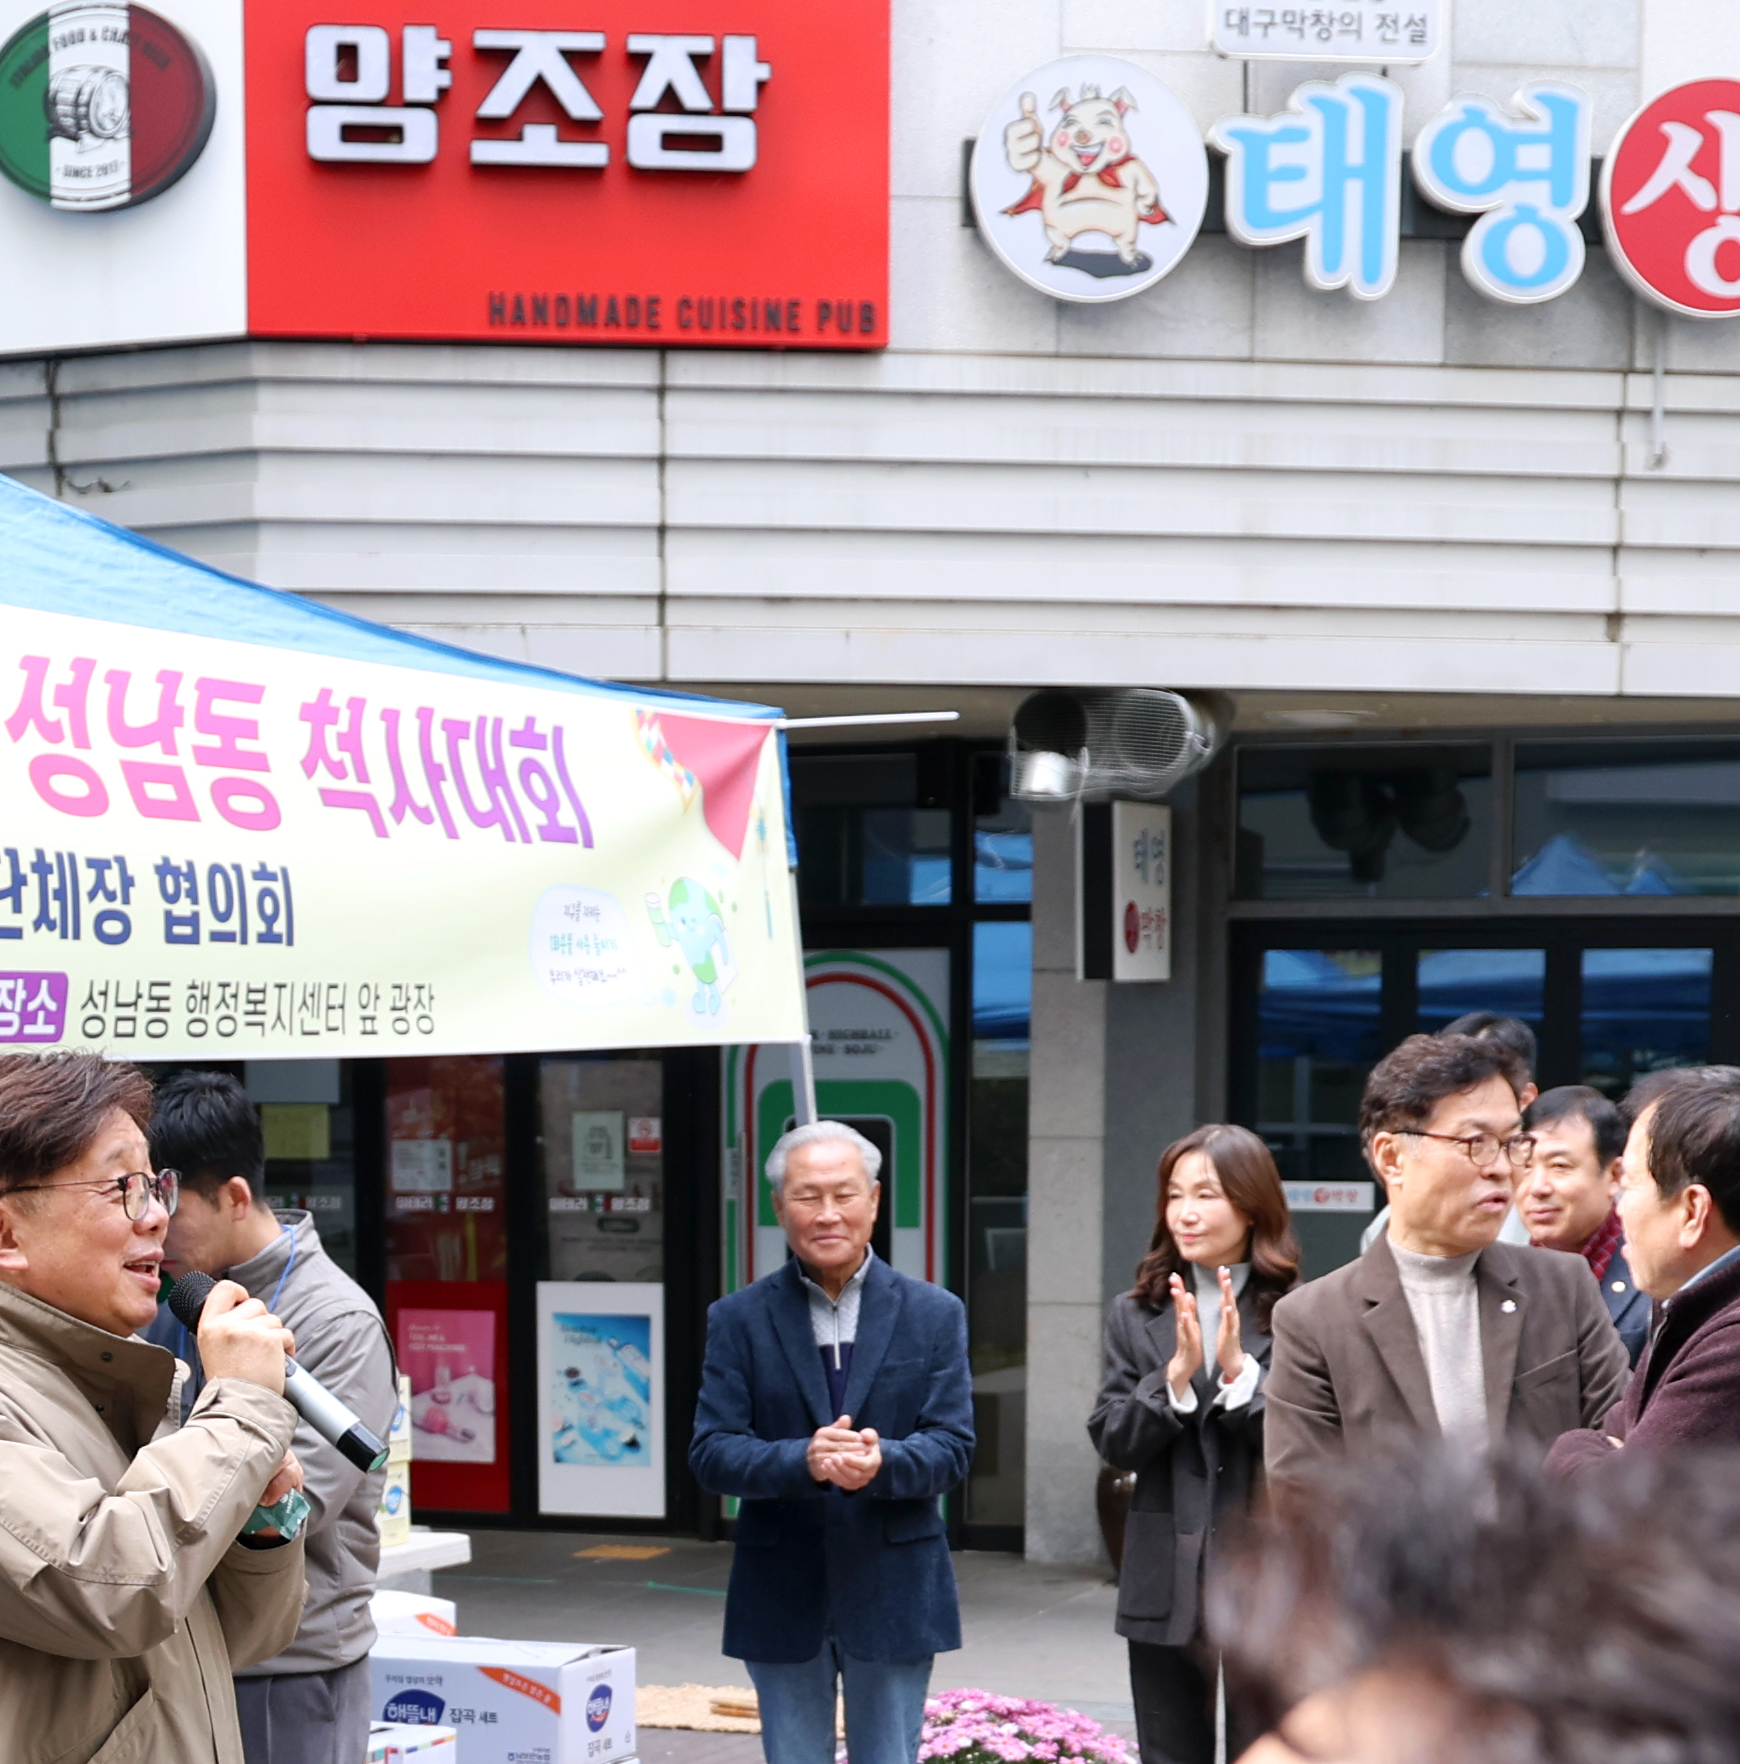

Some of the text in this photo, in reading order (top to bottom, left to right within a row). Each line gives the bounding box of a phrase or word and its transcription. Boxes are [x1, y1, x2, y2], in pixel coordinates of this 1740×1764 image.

[53, 27, 85, 50] FOOD
[1225, 8, 1428, 44] 대구막창의 전설
[304, 23, 772, 173] 양조장
[63, 164, 92, 178] SINCE
[488, 290, 878, 334] HANDMADE CUISINE PUB
[4, 654, 282, 832] 성남동
[299, 687, 595, 849] 척사대회
[154, 855, 295, 947] 협의회
[79, 981, 172, 1041] 성남동
[184, 981, 348, 1038] 행정복지센터
[357, 981, 381, 1035] 앞
[389, 981, 436, 1037] 광장
[449, 1708, 499, 1724] 잡곡 세트
